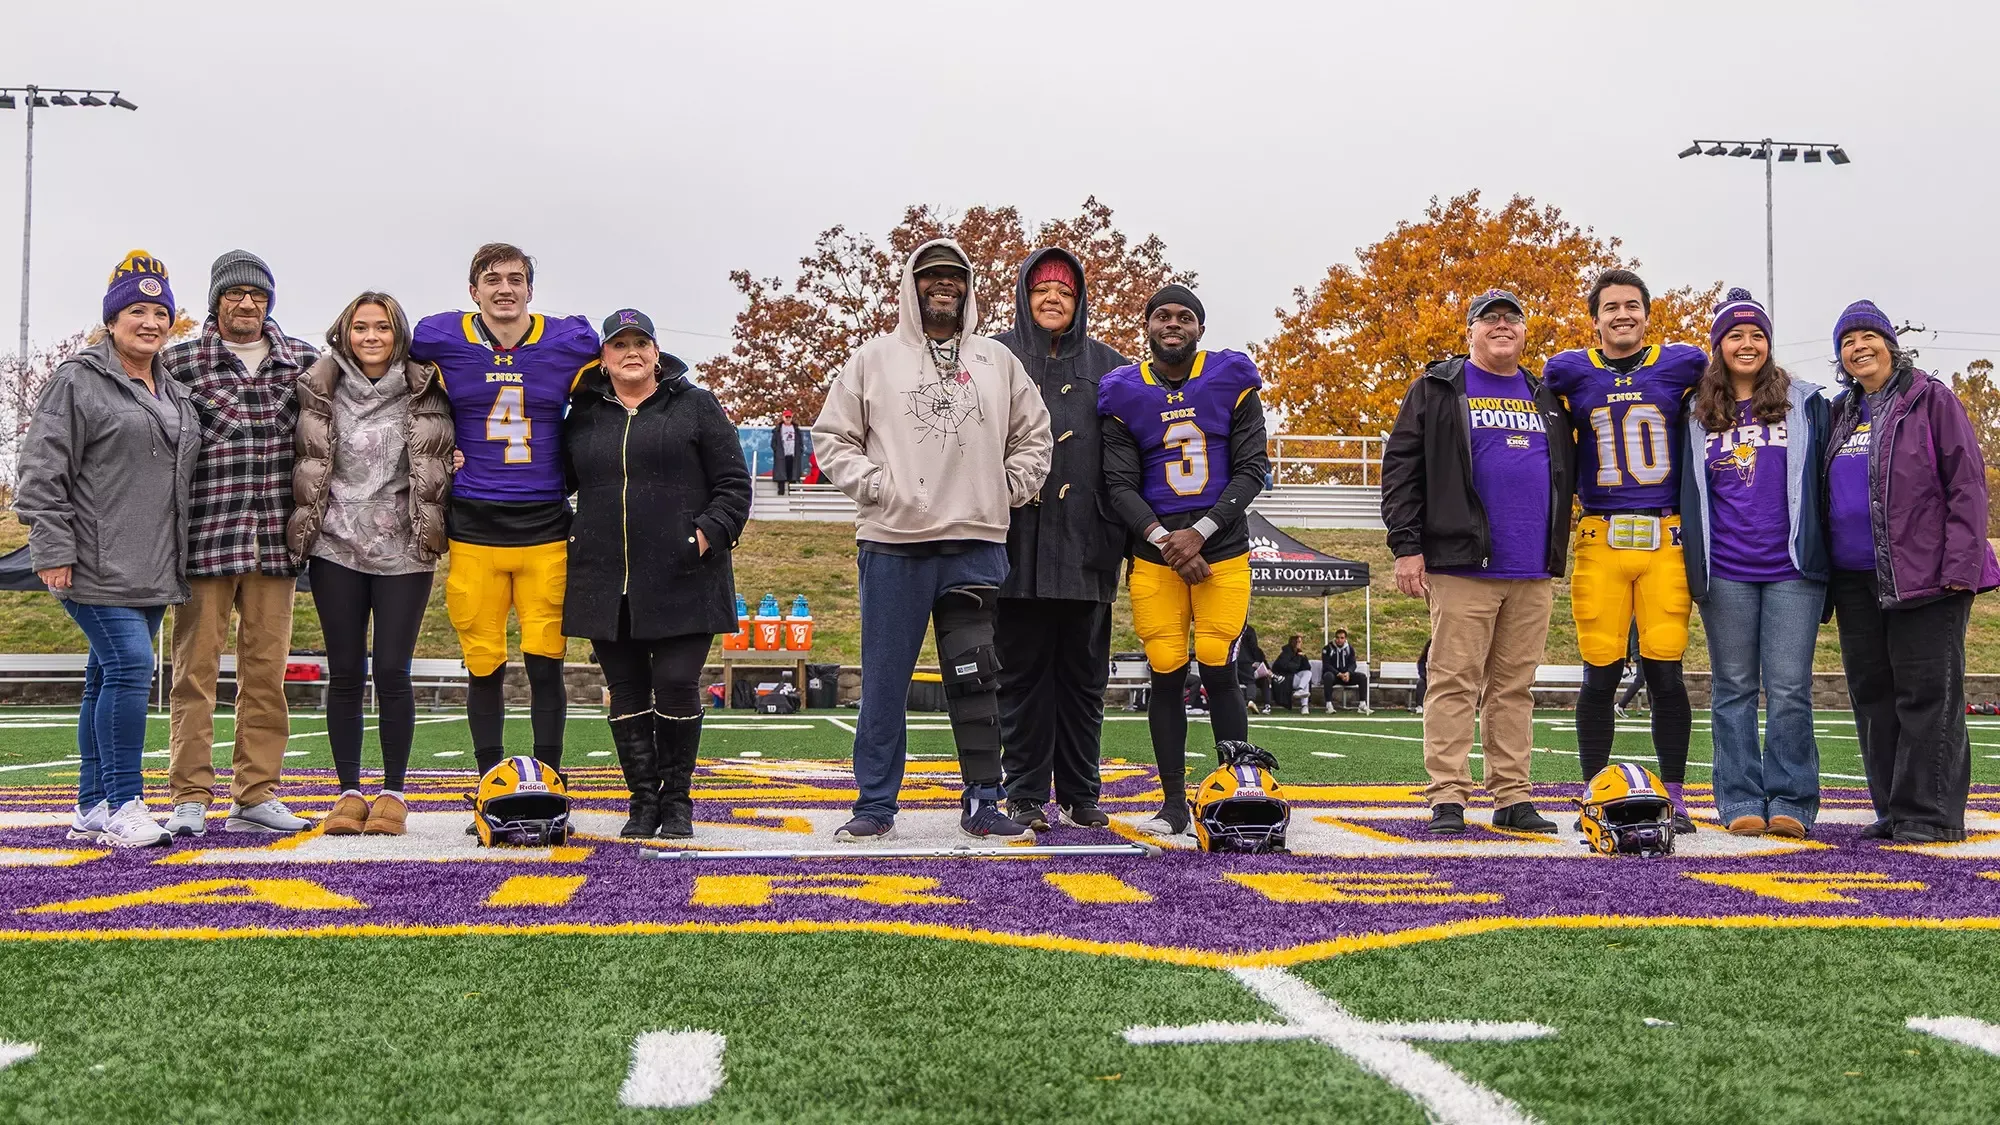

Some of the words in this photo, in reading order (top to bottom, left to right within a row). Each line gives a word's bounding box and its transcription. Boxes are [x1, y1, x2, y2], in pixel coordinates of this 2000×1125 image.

[618, 311, 639, 325] K
[485, 373, 523, 383] KNOX
[1606, 392, 1643, 403] KNOX
[1467, 398, 1504, 411] KNOX
[1160, 408, 1197, 422] KNOX
[486, 386, 532, 464] 4
[1506, 438, 1530, 446] KNOX
[1590, 404, 1671, 487] 10
[1705, 421, 1788, 460] FIRE
[1838, 446, 1869, 454] FOOTBAL
[1163, 420, 1209, 496] 3
[1275, 567, 1354, 581] FOOTBALL
[519, 783, 547, 791] Riddell
[1236, 789, 1264, 797] Riddell
